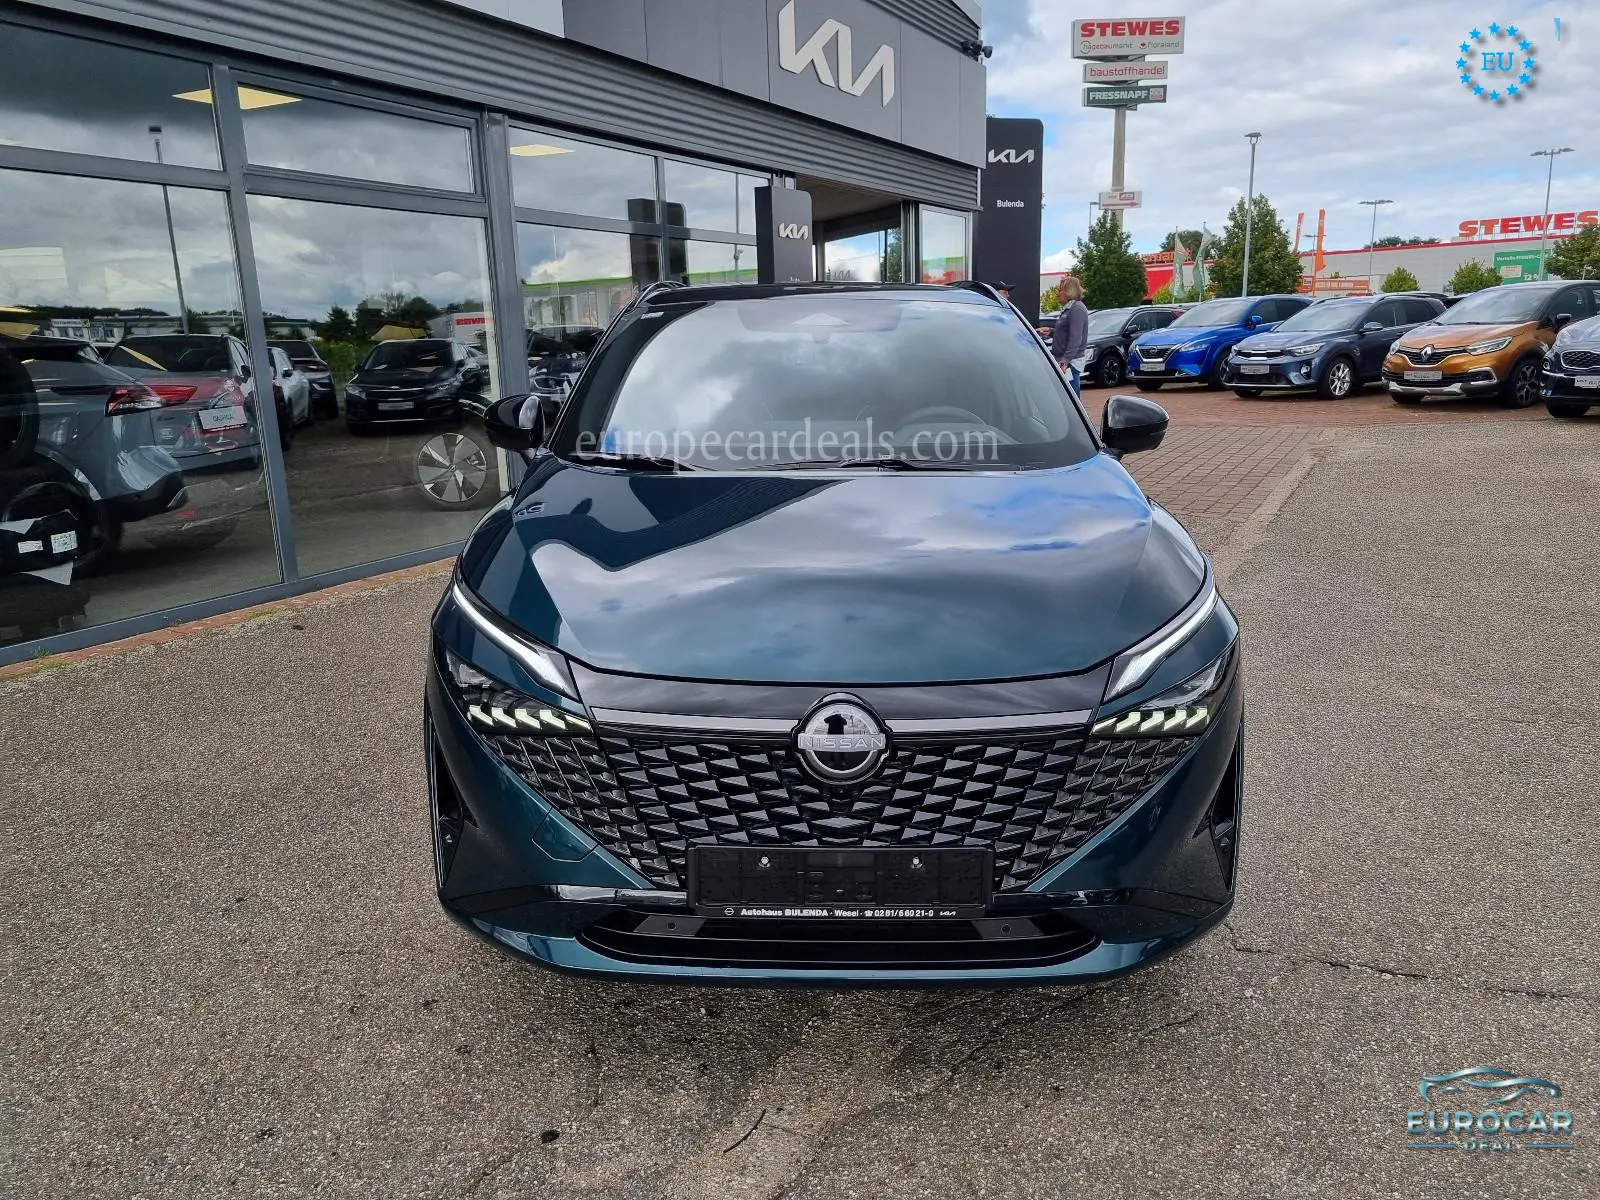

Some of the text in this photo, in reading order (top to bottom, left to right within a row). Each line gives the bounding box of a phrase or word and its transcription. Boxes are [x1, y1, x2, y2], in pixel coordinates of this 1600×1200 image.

[1080, 20, 1180, 38] STEWES
[1089, 65, 1165, 77] baustoffhandel
[1089, 90, 1149, 100] FRESSNAPF
[988, 149, 1035, 163] KIA
[996, 200, 1025, 208] Bulenda
[1458, 210, 1599, 238] STEWES
[800, 734, 883, 749] NISSAN
[740, 908, 783, 917] Autohaus
[784, 908, 829, 917] BULENDA
[834, 909, 859, 917] Wesel
